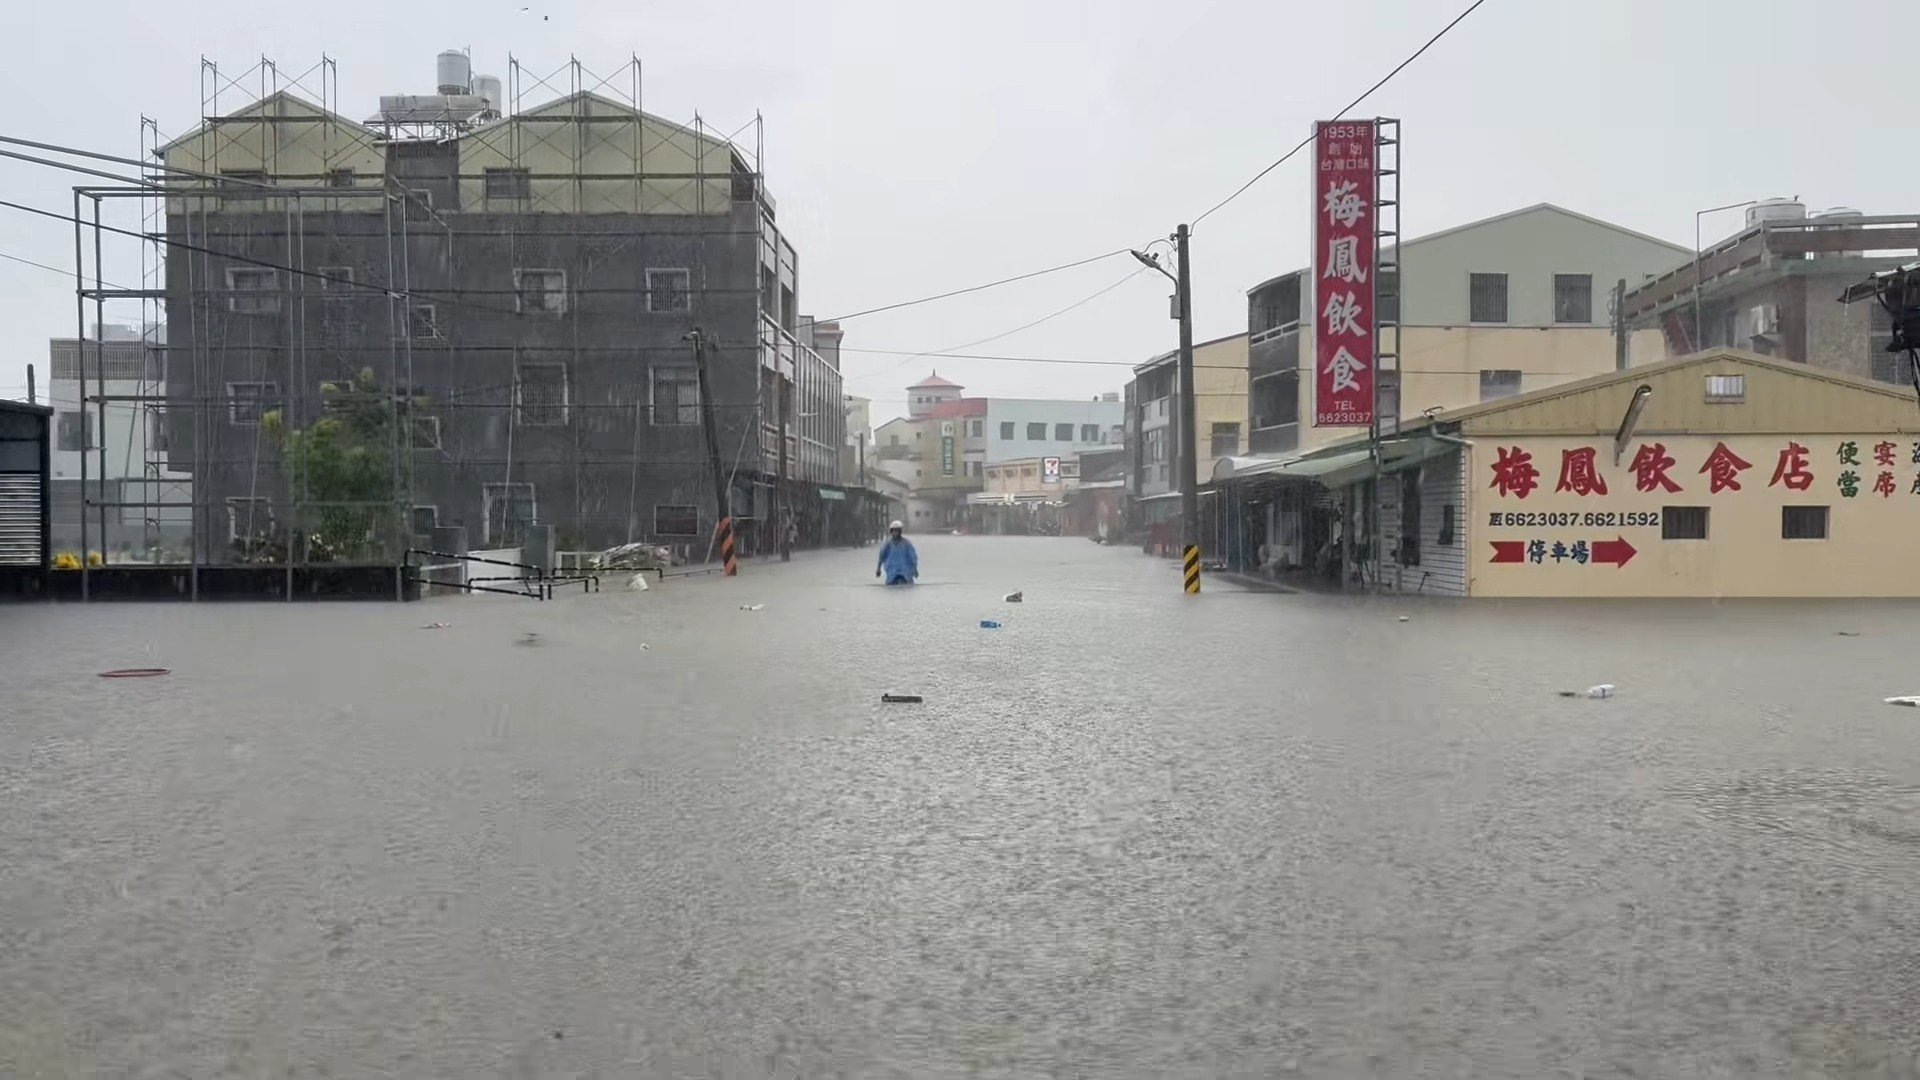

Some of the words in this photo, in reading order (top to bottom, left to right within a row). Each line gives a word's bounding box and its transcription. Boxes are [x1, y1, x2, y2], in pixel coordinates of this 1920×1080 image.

[1324, 126, 1367, 139] 1953年
[1323, 178, 1368, 394] 梅鳳飲食
[1319, 412, 1371, 423] 6623037
[1334, 400, 1356, 411] TEL
[1489, 441, 1815, 499] 梅鳳飲食店
[1836, 441, 1861, 498] 便當
[1873, 441, 1897, 498] 宴席
[1526, 539, 1590, 564] 停車場
